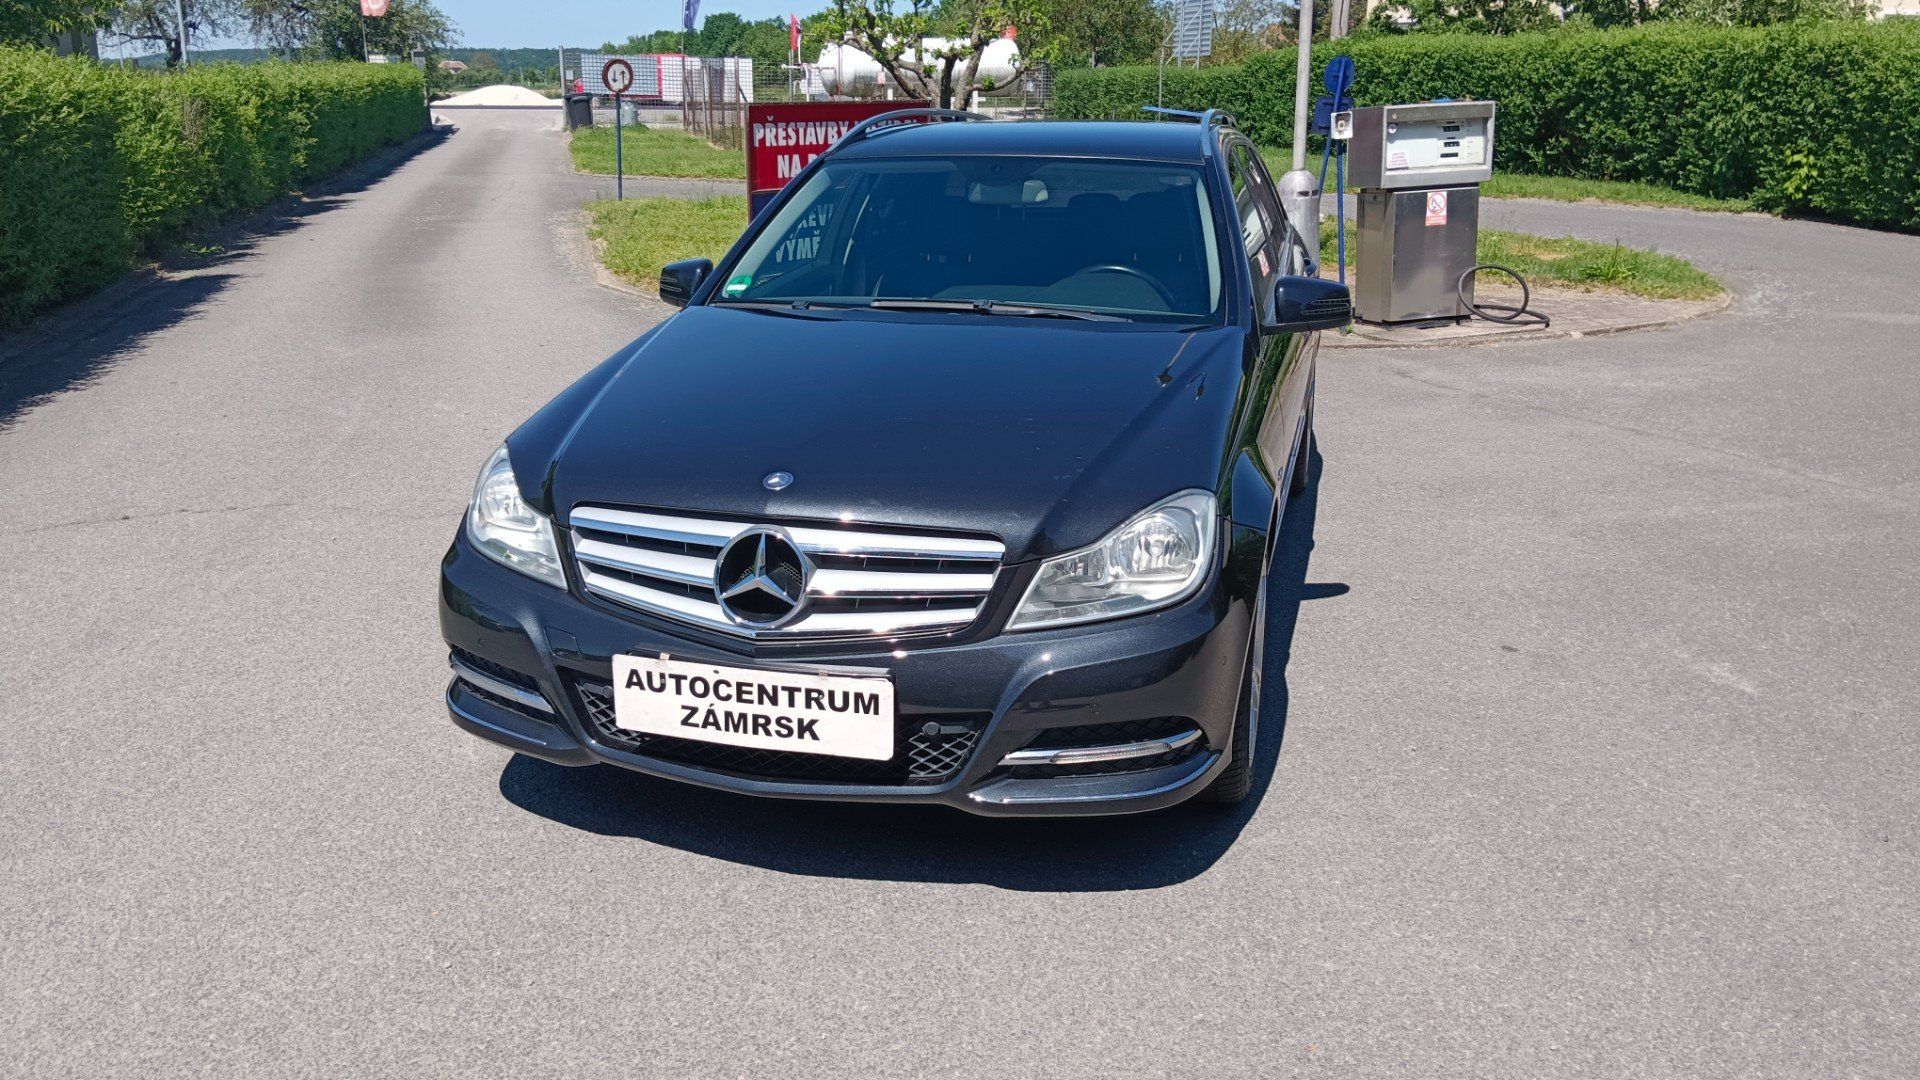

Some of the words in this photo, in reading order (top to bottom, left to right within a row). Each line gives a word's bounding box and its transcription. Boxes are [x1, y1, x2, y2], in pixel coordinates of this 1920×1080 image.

[753, 115, 849, 147] PŘESTAVBY
[777, 153, 802, 178] NA
[775, 229, 821, 263] VÝMĚ
[625, 668, 880, 716] AUTOCENTRUM
[680, 703, 820, 741] ZÁMRSK
